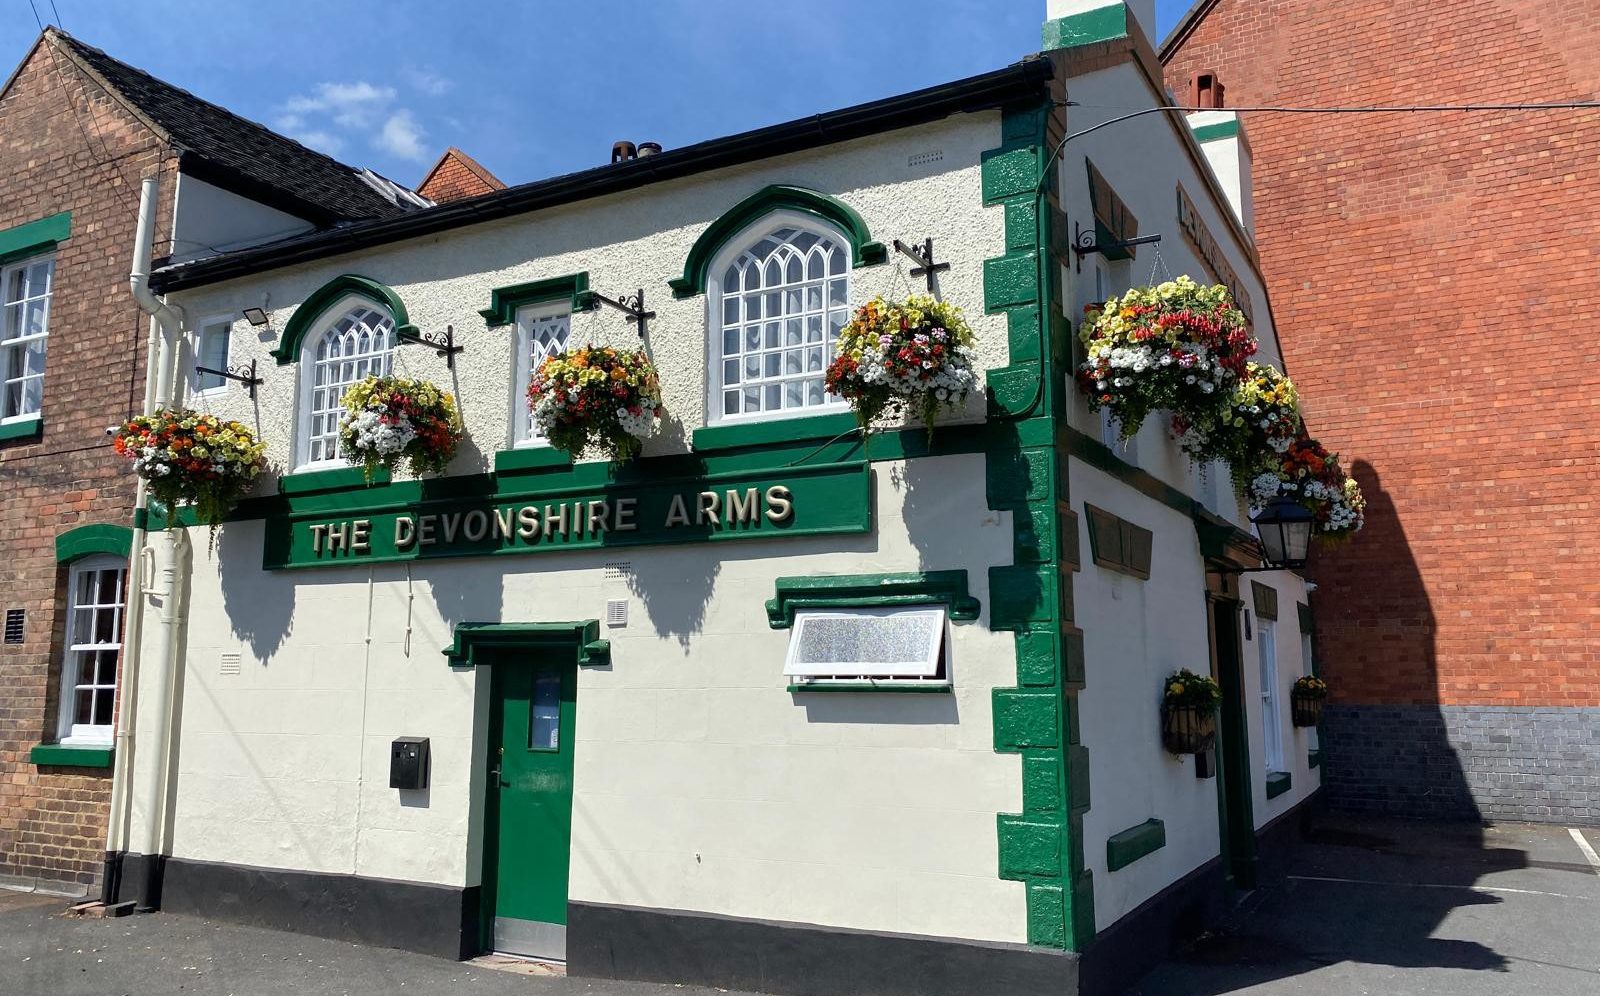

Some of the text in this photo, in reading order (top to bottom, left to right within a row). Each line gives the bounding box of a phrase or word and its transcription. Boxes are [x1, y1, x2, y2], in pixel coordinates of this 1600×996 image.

[309, 485, 793, 552] THE DEVONSHIRE ARMS
